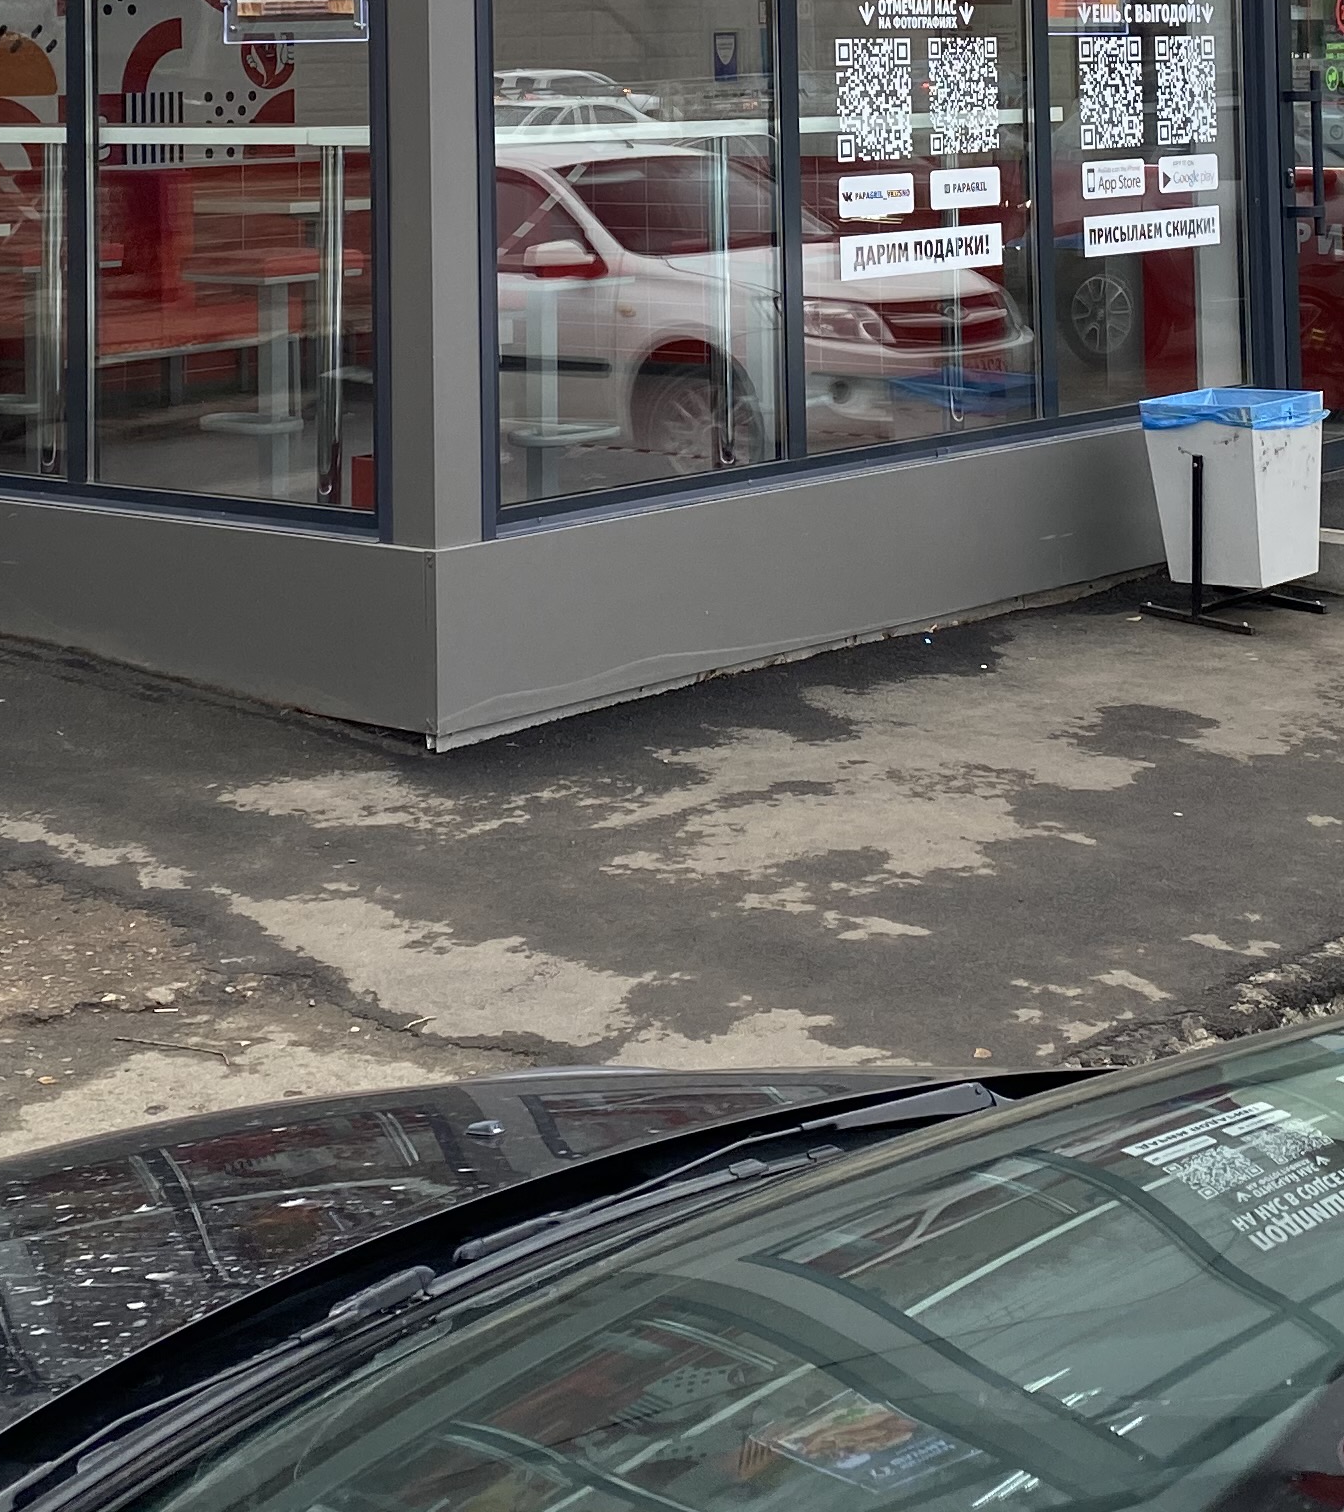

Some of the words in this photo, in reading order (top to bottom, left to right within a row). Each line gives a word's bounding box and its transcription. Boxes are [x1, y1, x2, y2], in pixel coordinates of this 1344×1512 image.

[1092, 3, 1122, 23] ЕШЬ
[1124, 2, 1133, 23] С
[878, 16, 892, 30] НА
[893, 16, 958, 30] ФОТОГРАФИЯХ
[1098, 176, 1117, 194] App
[1118, 174, 1142, 190] Store
[1173, 169, 1199, 187] Google
[1088, 221, 1163, 246] ПРИСЫЛАЕМ
[1165, 216, 1215, 240] СКИДКИ!
[853, 242, 909, 272] ДАРИМ
[913, 234, 990, 264] ПОДАРКИ!
